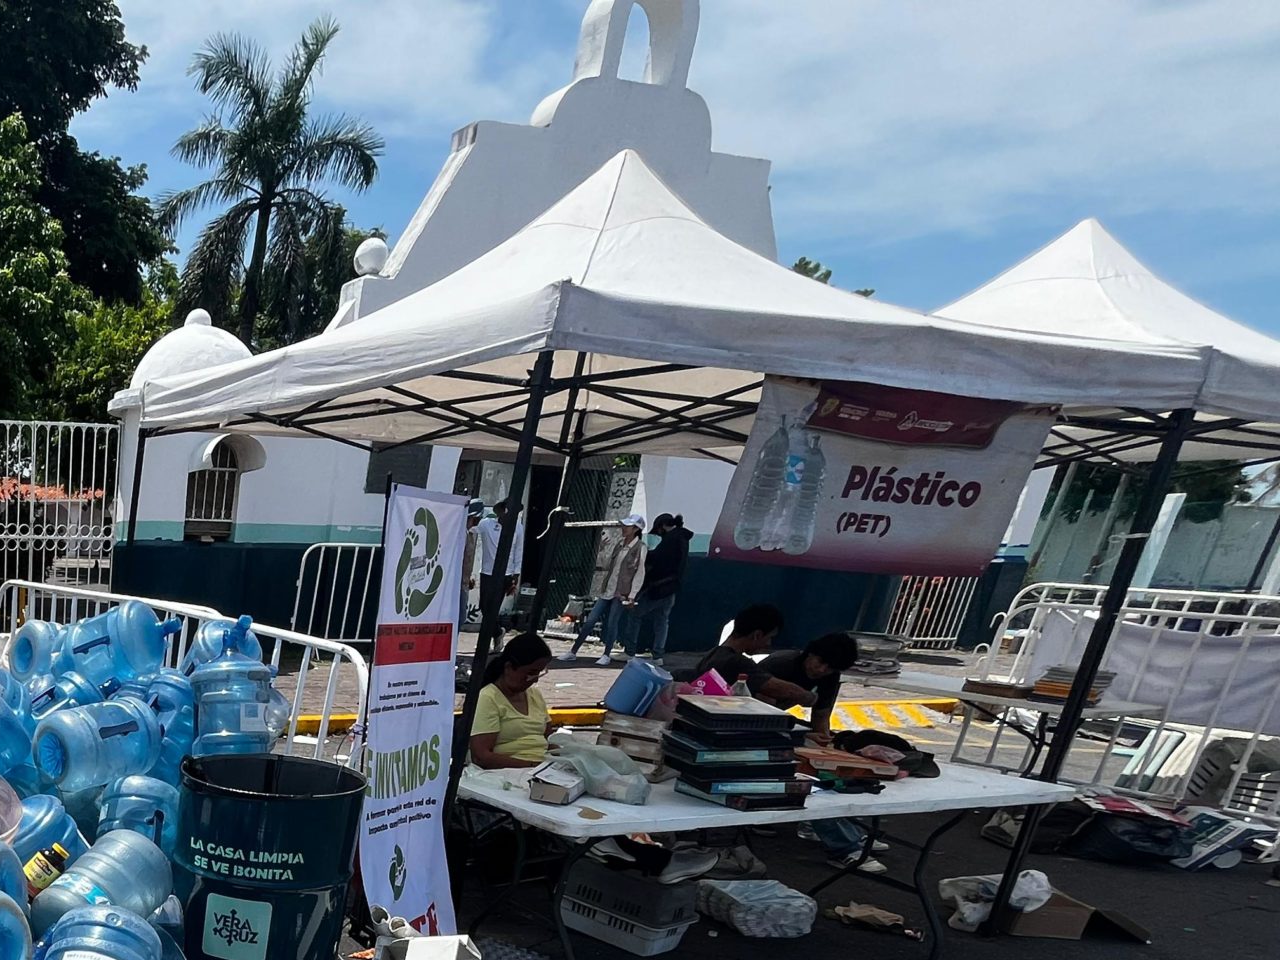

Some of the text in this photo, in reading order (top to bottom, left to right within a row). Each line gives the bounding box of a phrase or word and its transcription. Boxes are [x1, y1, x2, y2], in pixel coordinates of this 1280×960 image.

[841, 465, 981, 508] Plástico
[836, 512, 891, 538] (PET)
[375, 734, 441, 799] INVITAMOS
[426, 797, 437, 805] de
[191, 837, 305, 864] LA CASA LIMPIA
[194, 855, 294, 880] SE VE BONITA
[213, 911, 252, 930] VERA
[218, 927, 259, 944] CRUZ
